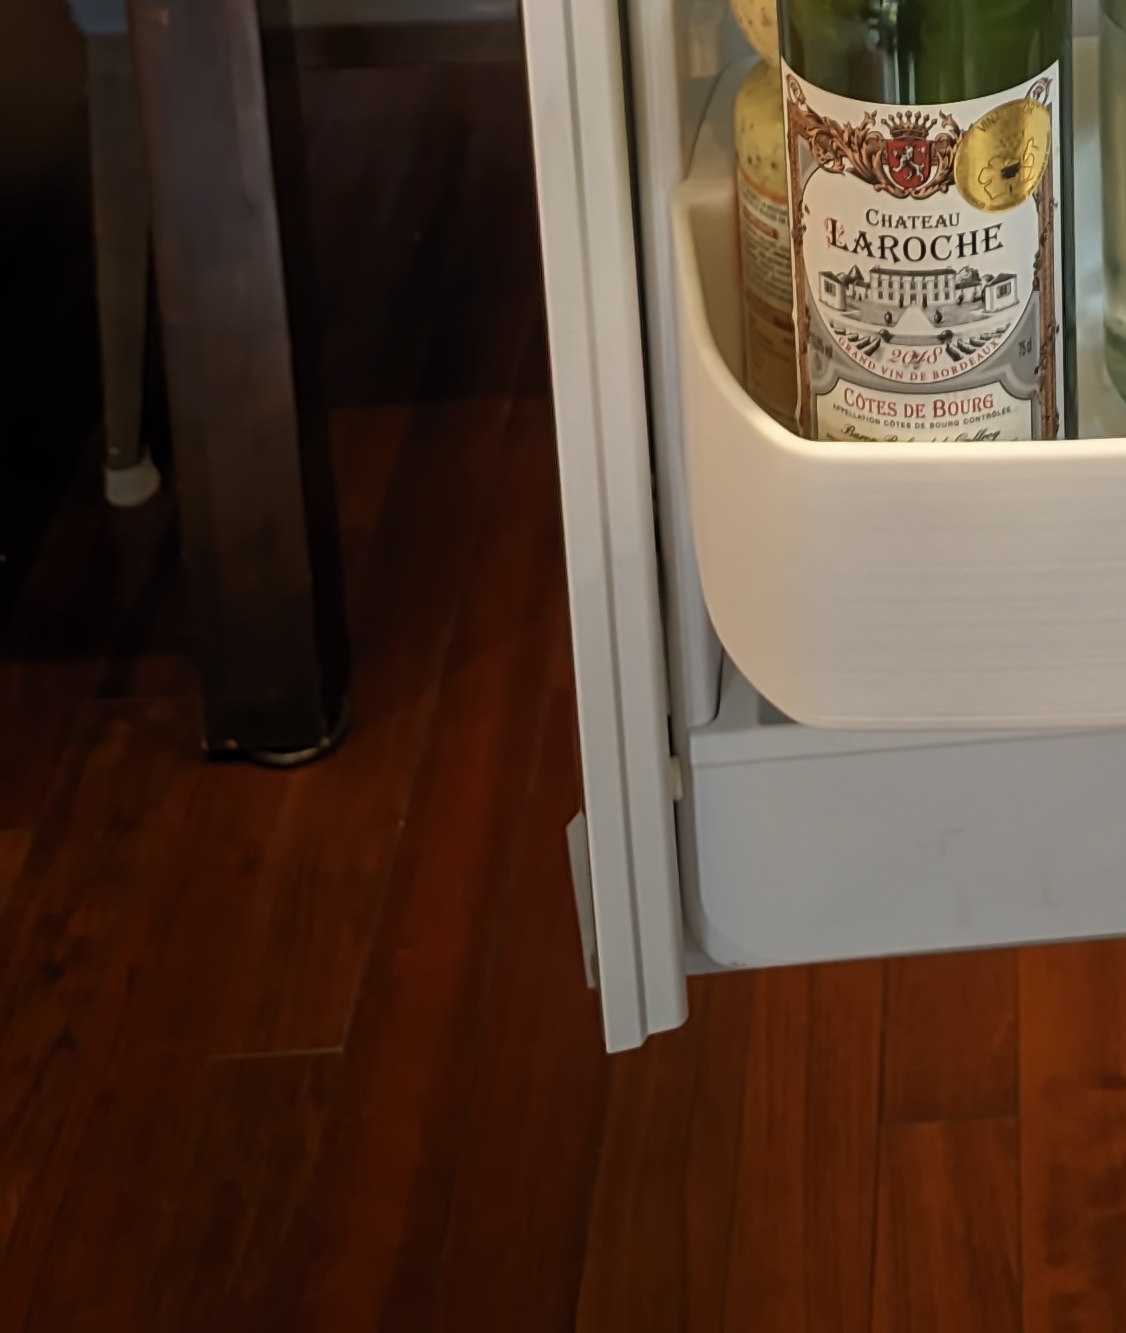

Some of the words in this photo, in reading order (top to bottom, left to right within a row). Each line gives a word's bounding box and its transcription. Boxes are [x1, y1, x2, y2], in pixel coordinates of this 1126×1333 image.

[866, 209, 960, 229] CHATEAU
[826, 218, 1003, 263] LAROCHE
[838, 336, 877, 371] GRAND
[881, 364, 904, 381] VIN
[910, 371, 927, 382] DE
[932, 338, 1000, 380] BORDEAUX
[890, 346, 943, 367] 2018
[832, 403, 881, 425] APPELLATION
[883, 419, 911, 430] CÔTES
[914, 421, 926, 430] DE
[929, 419, 960, 430] BOURG
[844, 387, 898, 419] CÔTES
[903, 403, 926, 419] DE
[932, 393, 994, 419] BOURG
